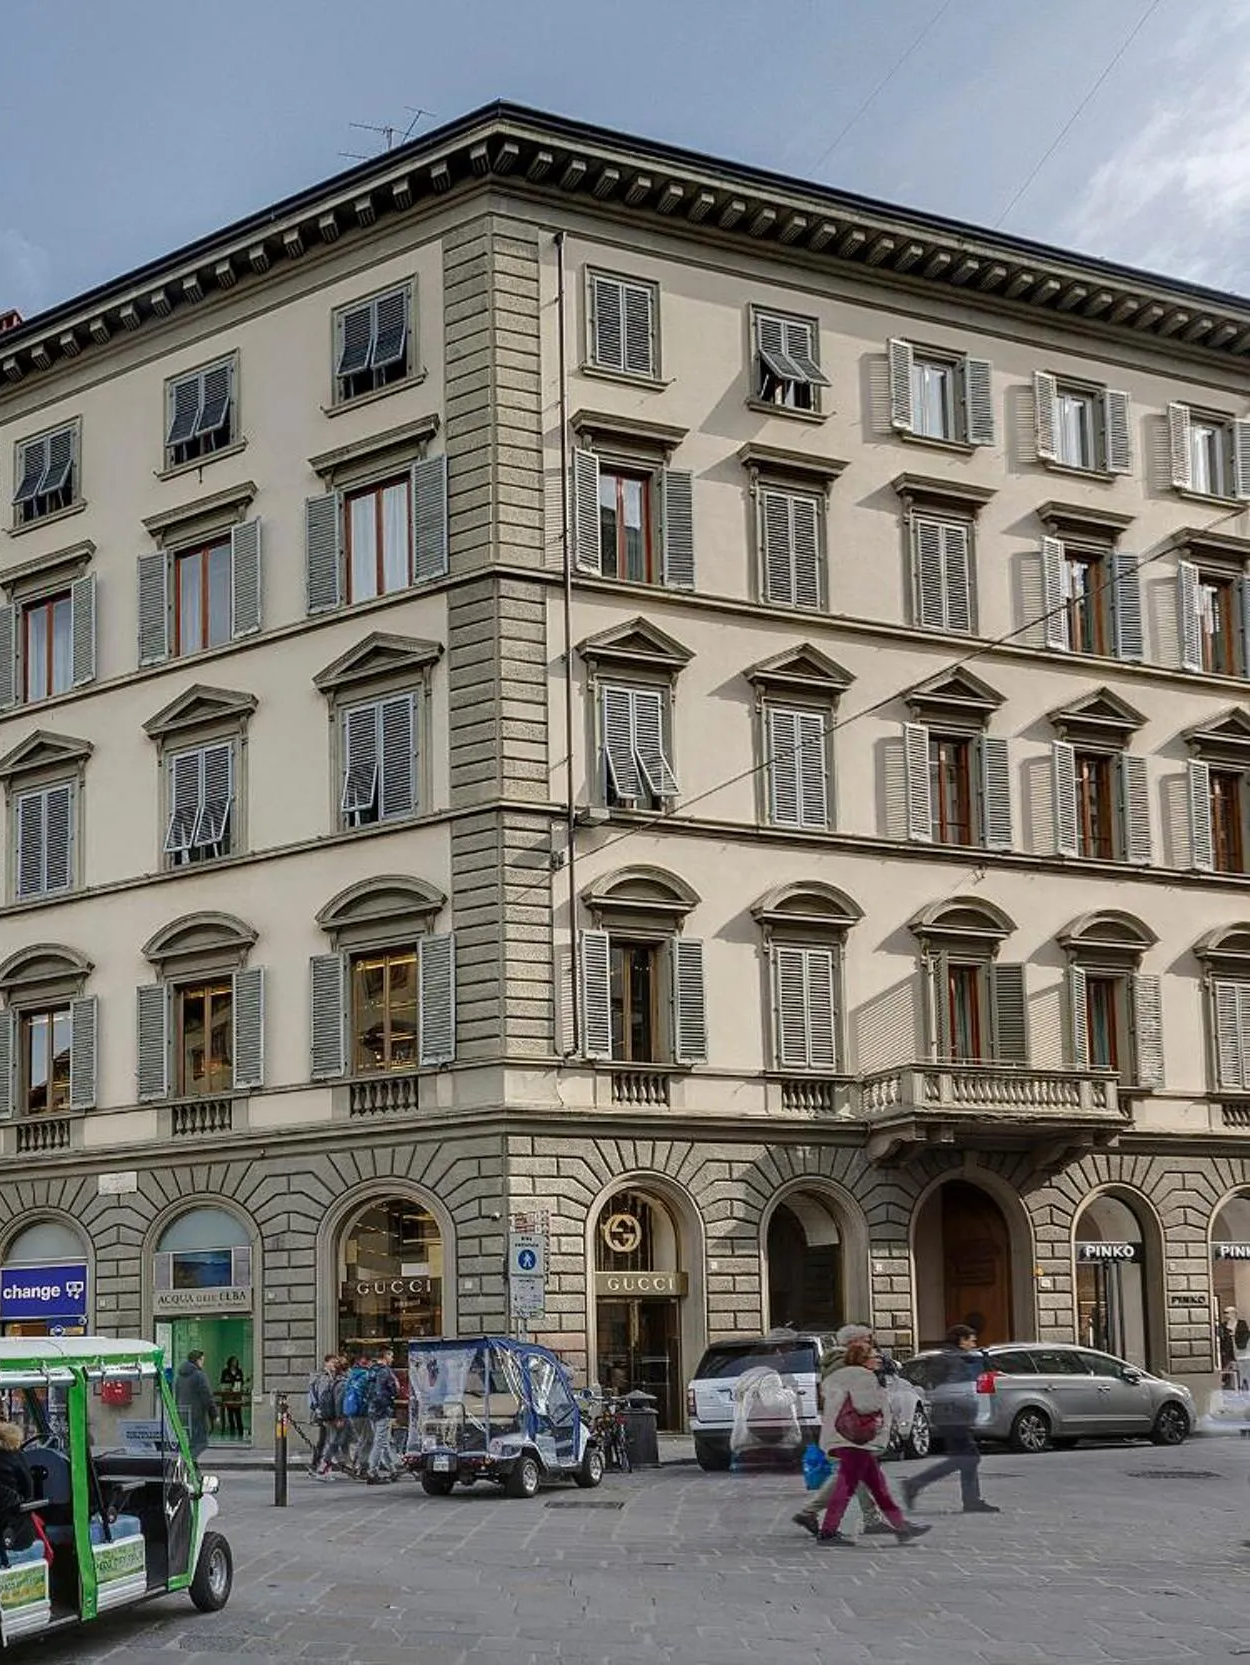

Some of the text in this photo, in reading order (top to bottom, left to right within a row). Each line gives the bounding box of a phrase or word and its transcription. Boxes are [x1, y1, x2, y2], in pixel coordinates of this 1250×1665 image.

[1084, 1244, 1135, 1258] PINKO
[356, 1279, 432, 1296] GUCCI
[608, 1277, 675, 1292] GUCCI
[2, 1284, 62, 1301] change
[1170, 1295, 1207, 1305] PINKO
